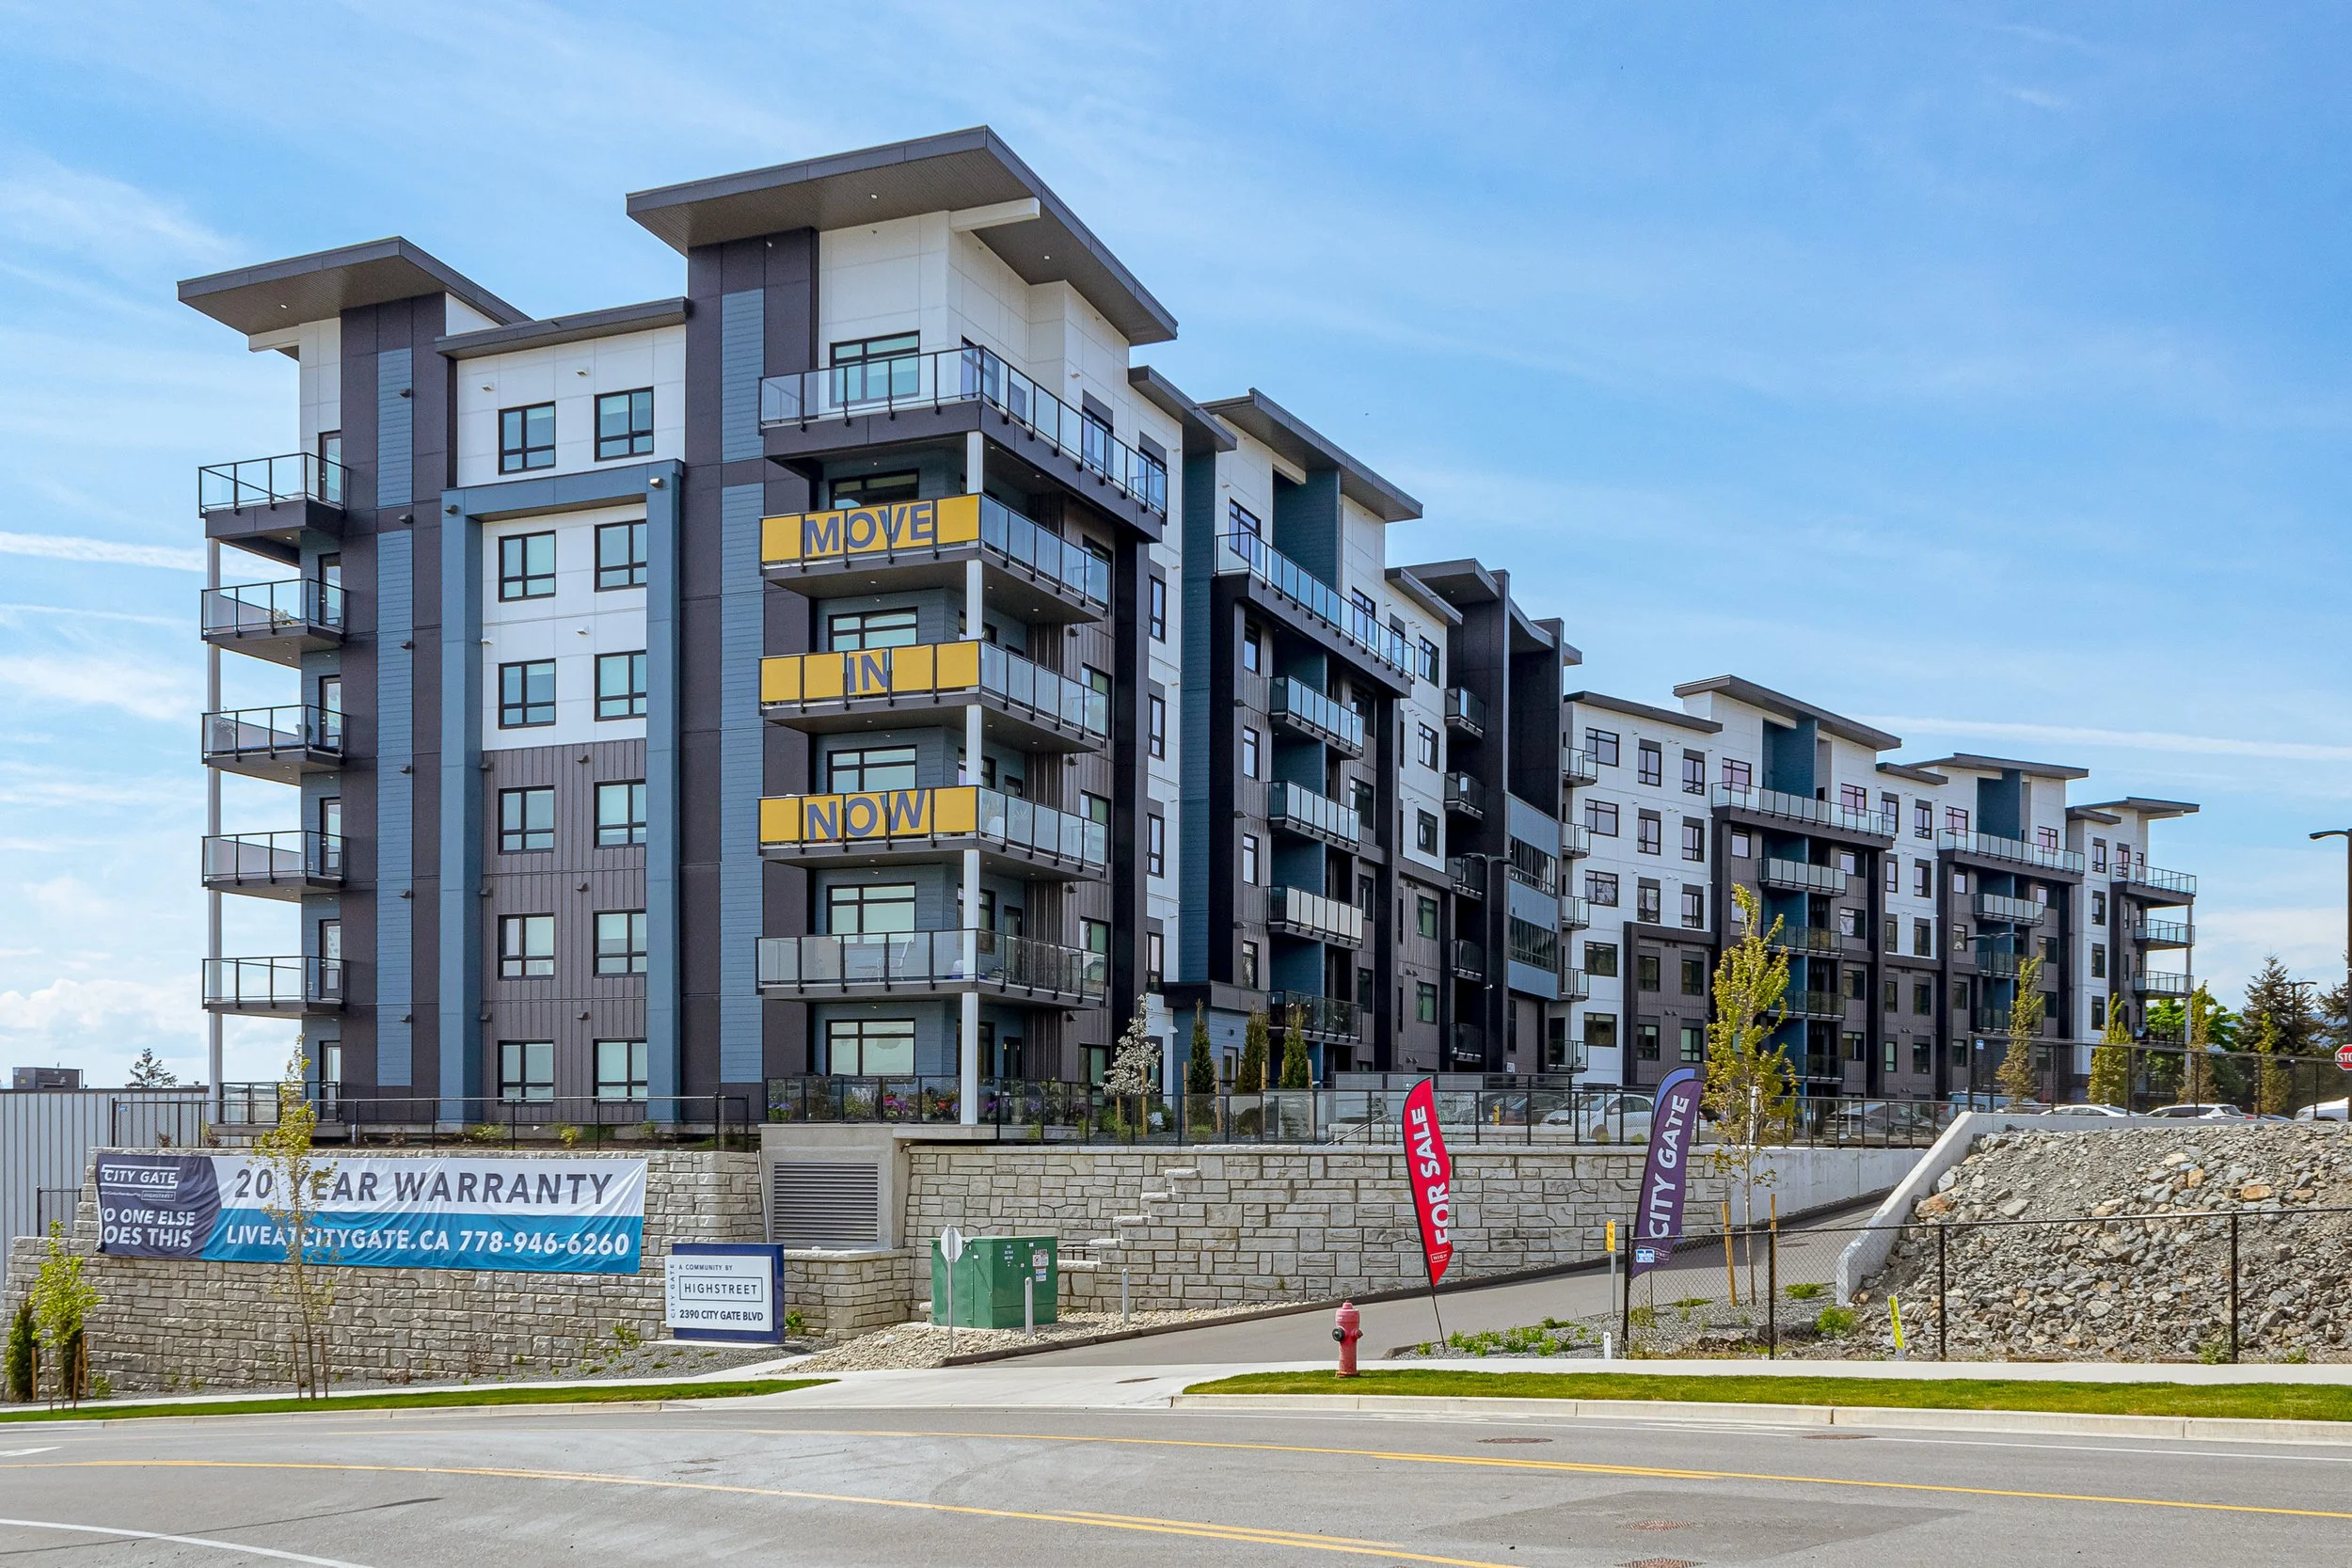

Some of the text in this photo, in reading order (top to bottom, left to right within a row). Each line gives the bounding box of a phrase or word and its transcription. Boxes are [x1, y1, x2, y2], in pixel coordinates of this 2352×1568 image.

[804, 503, 933, 554] MOVE
[848, 651, 888, 693] IN
[807, 790, 926, 840] NOW
[2338, 1053, 2352, 1063] STO
[103, 1169, 177, 1184] CITY GATE
[1411, 1105, 1449, 1245] FOR SALE
[1648, 1095, 1690, 1238] CITY GATE
[235, 1168, 273, 1199] 20
[394, 1172, 613, 1204] WARRANTY
[119, 1209, 155, 1224] ONE
[157, 1211, 196, 1226] ELSE
[103, 1225, 193, 1248] OES THIS
[458, 1230, 629, 1256] 778-946-6260
[684, 1283, 757, 1295] HIGHSTREET
[679, 1309, 764, 1322] 2390 CITY GATE BLVD
